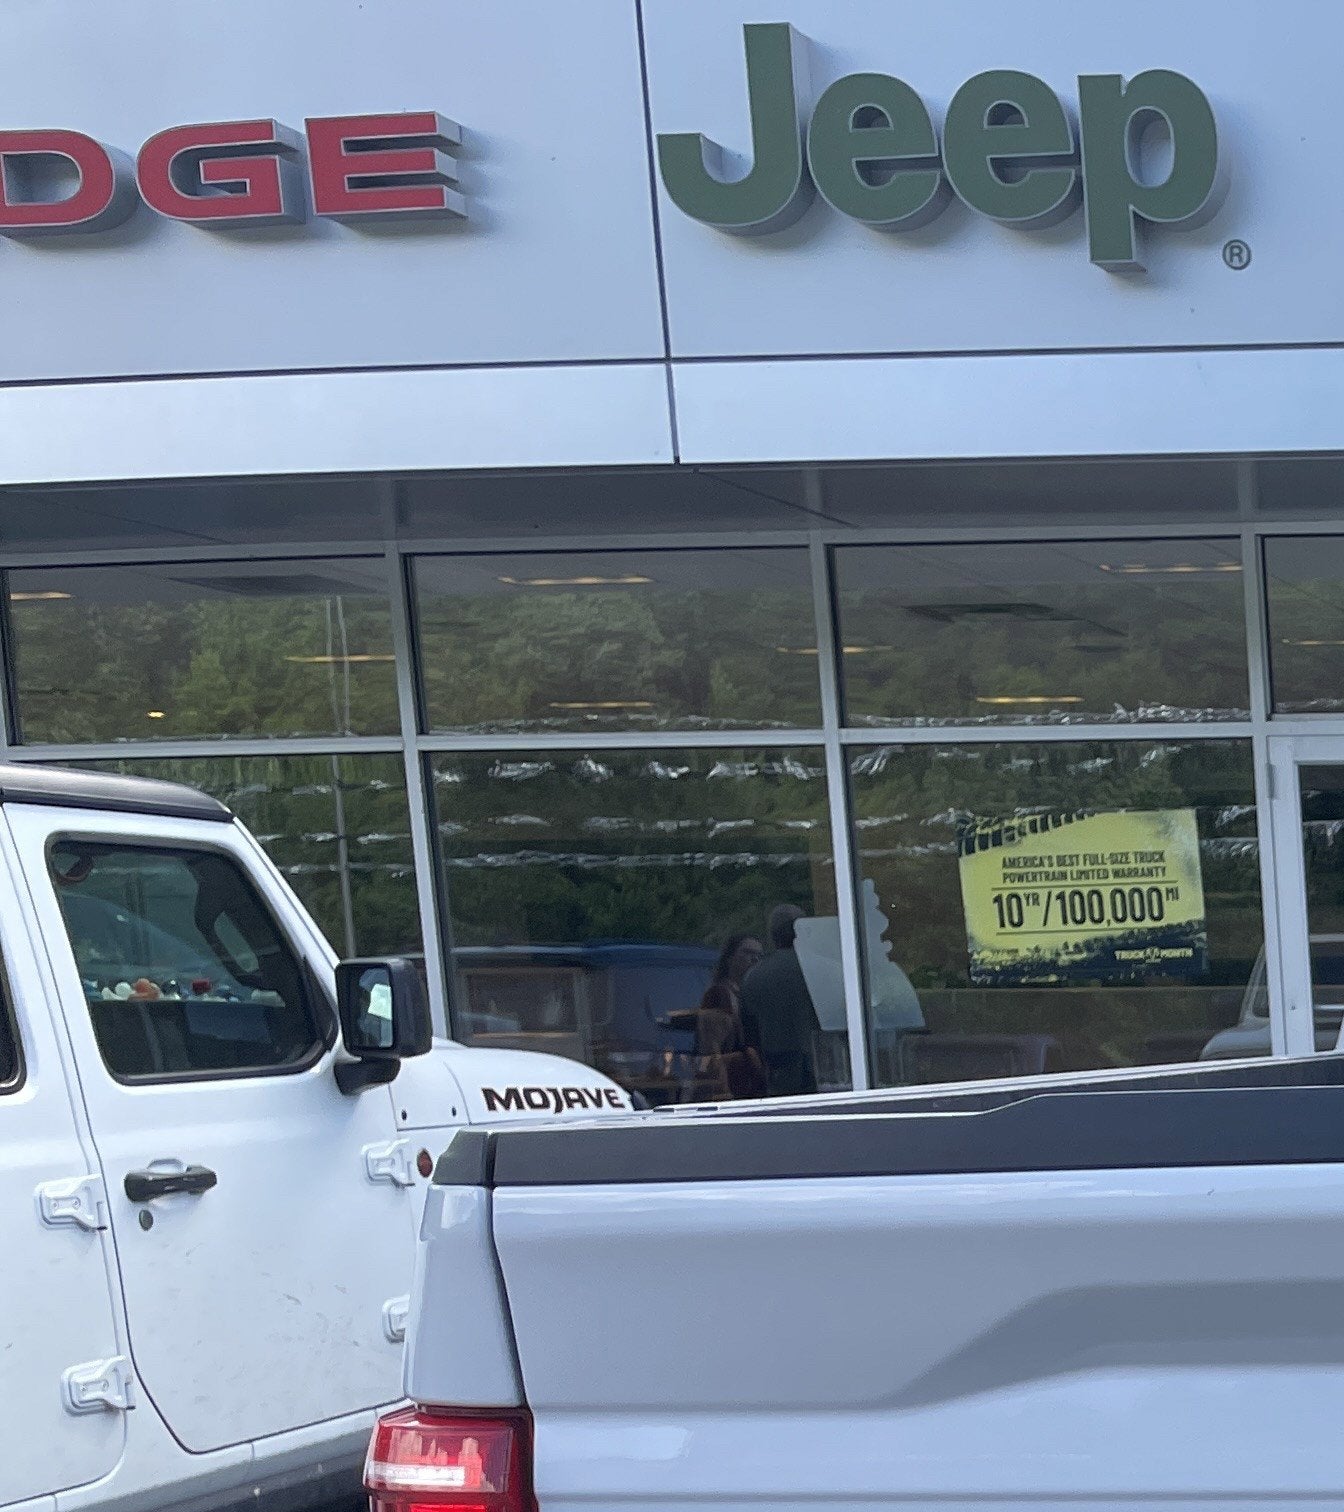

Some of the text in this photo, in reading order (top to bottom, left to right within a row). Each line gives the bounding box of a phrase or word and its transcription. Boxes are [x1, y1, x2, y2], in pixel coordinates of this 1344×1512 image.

[656, 21, 1224, 270] Jeep
[1002, 850, 1166, 869] AMERICA'S BEST FULL-SIZE TRUCK
[1002, 865, 1166, 884] POWERTRAIN LIMITED WARRANTY
[480, 1087, 626, 1114] MOJAVE
